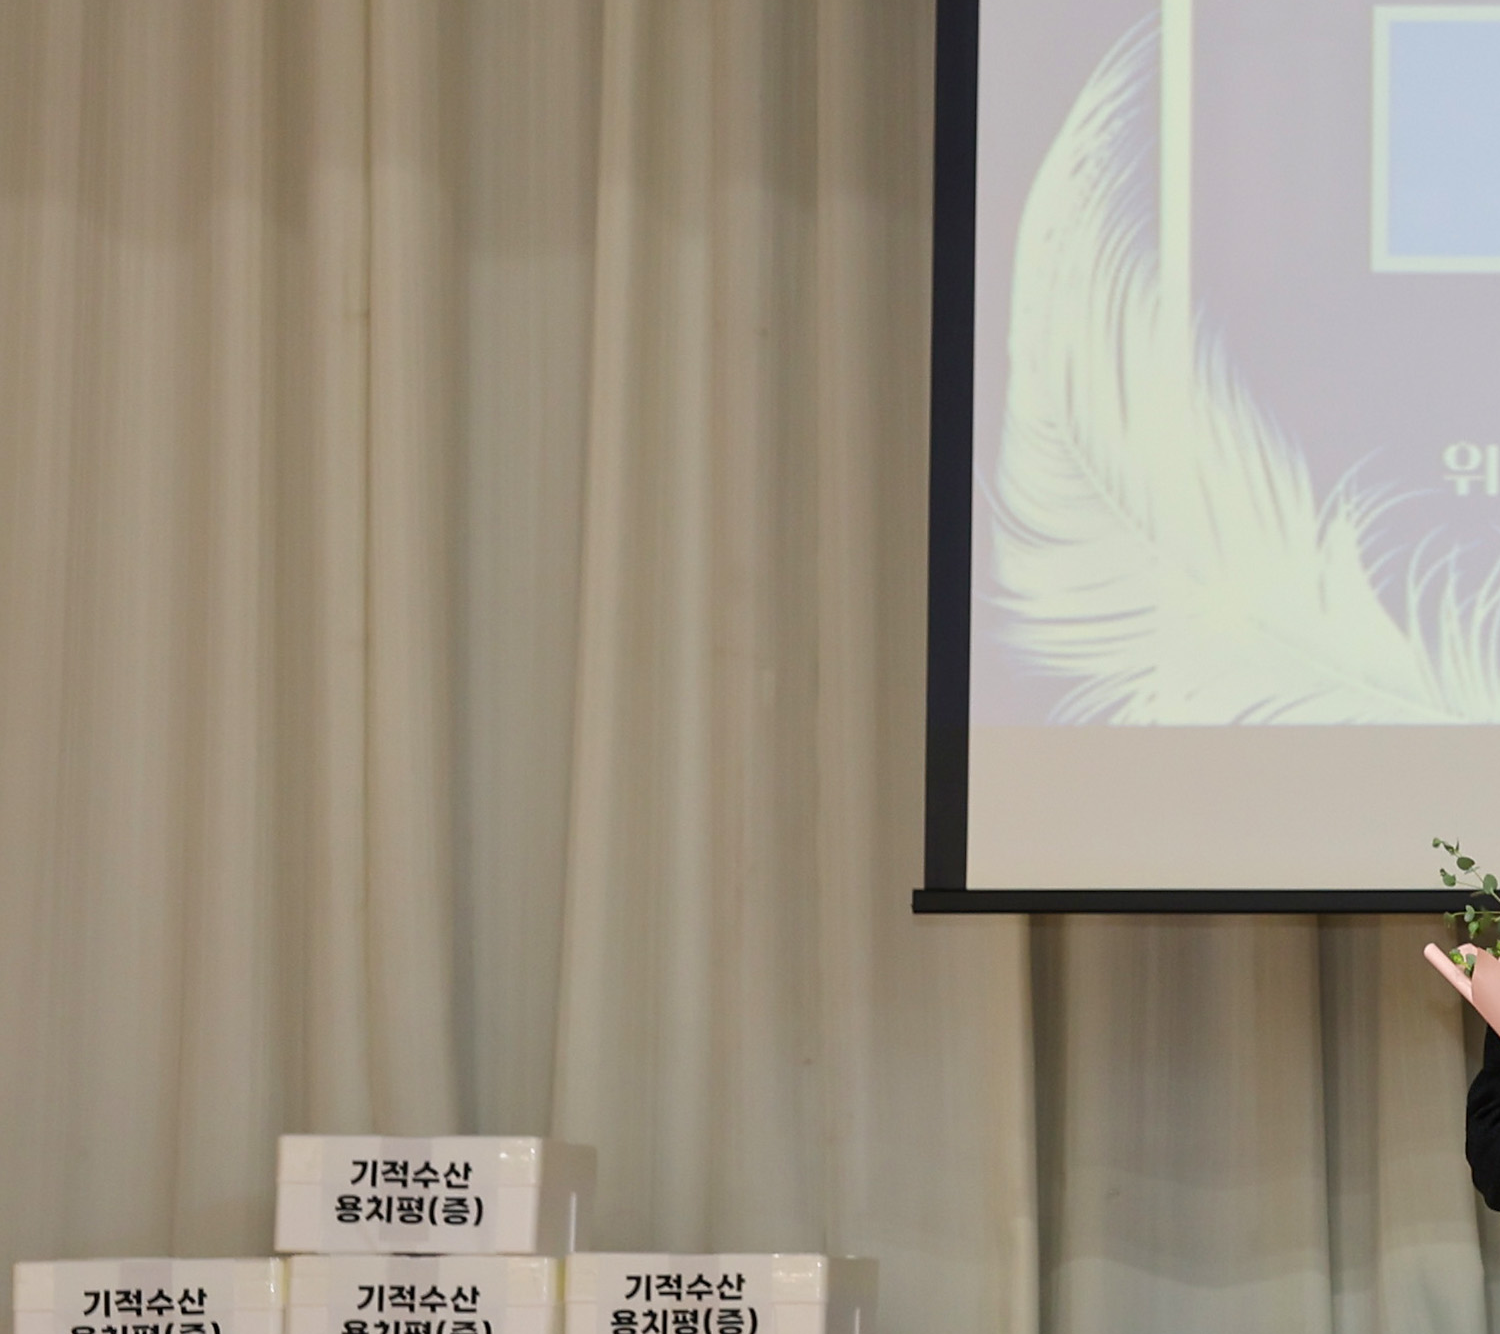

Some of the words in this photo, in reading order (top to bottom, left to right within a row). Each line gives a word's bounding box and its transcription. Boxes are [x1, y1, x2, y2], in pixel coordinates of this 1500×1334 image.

[1442, 440, 1500, 497] 위
[351, 1161, 472, 1189] 기적수산
[335, 1195, 483, 1226] 용치평(증)
[358, 1285, 479, 1313] 기적수산
[626, 1274, 745, 1301] 기적수산
[84, 1288, 207, 1317] 기적수산
